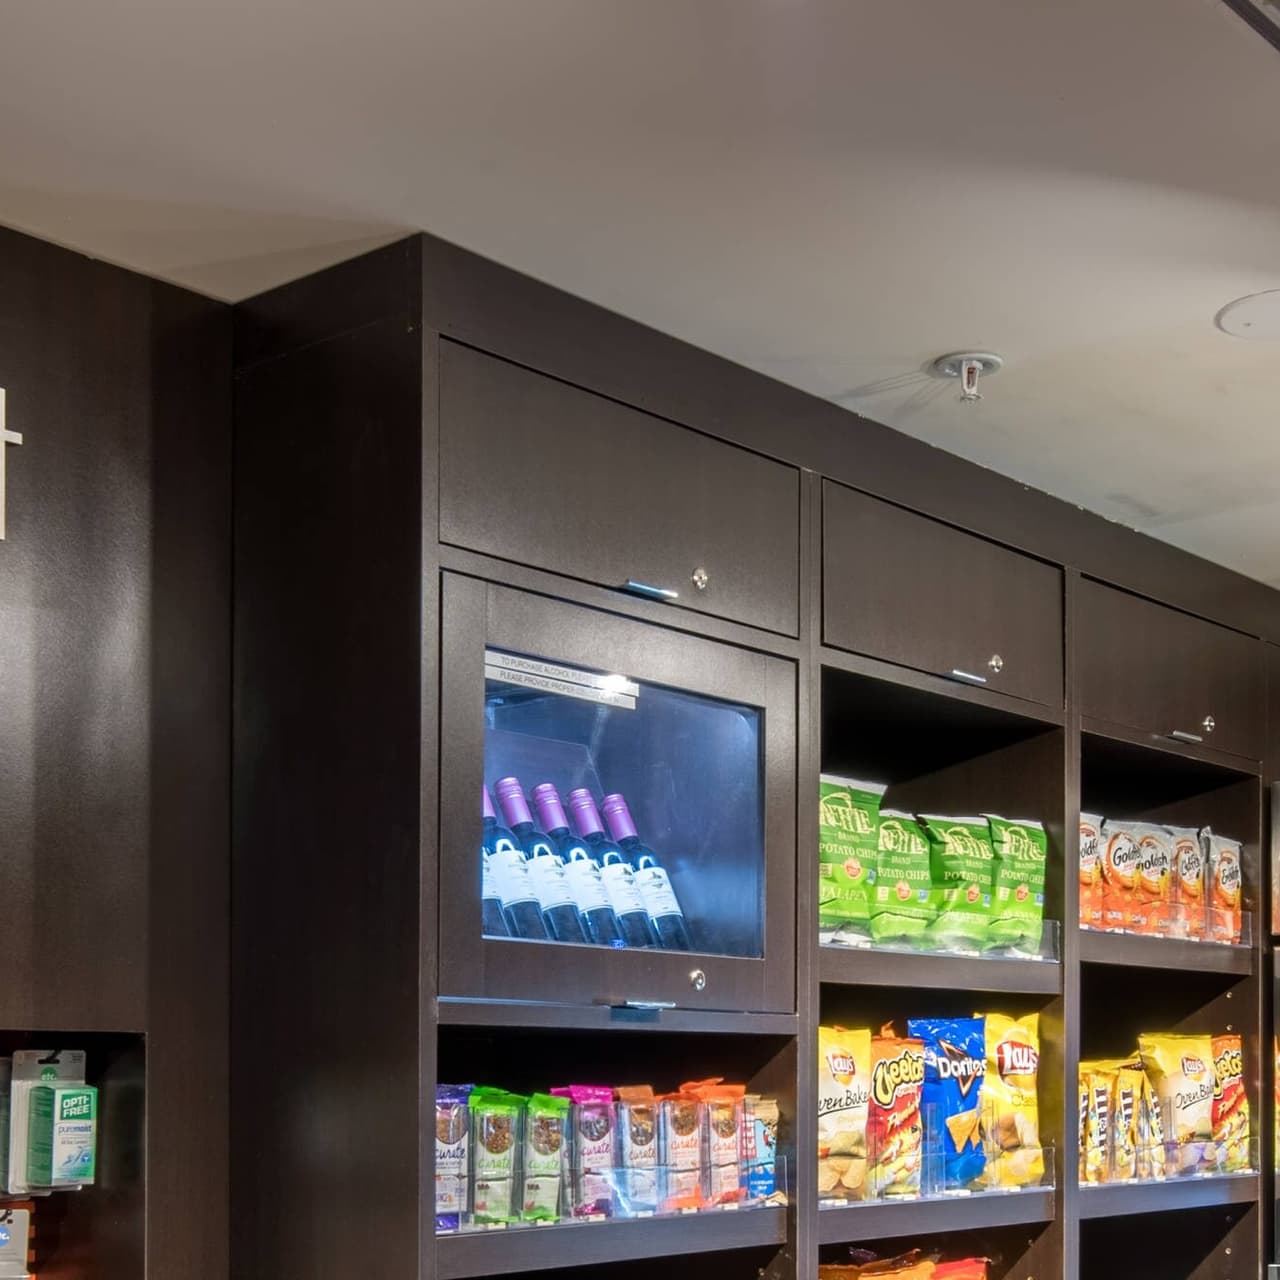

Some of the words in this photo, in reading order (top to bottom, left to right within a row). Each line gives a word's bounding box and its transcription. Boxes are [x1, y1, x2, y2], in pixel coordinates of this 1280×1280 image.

[820, 843, 854, 856] POTATO
[906, 870, 929, 880] CHIPS
[63, 1096, 89, 1108] OPTI-
[63, 1105, 89, 1117] FREE
[436, 1148, 465, 1159] curate
[582, 1143, 610, 1156] curate
[629, 1149, 656, 1161] curate
